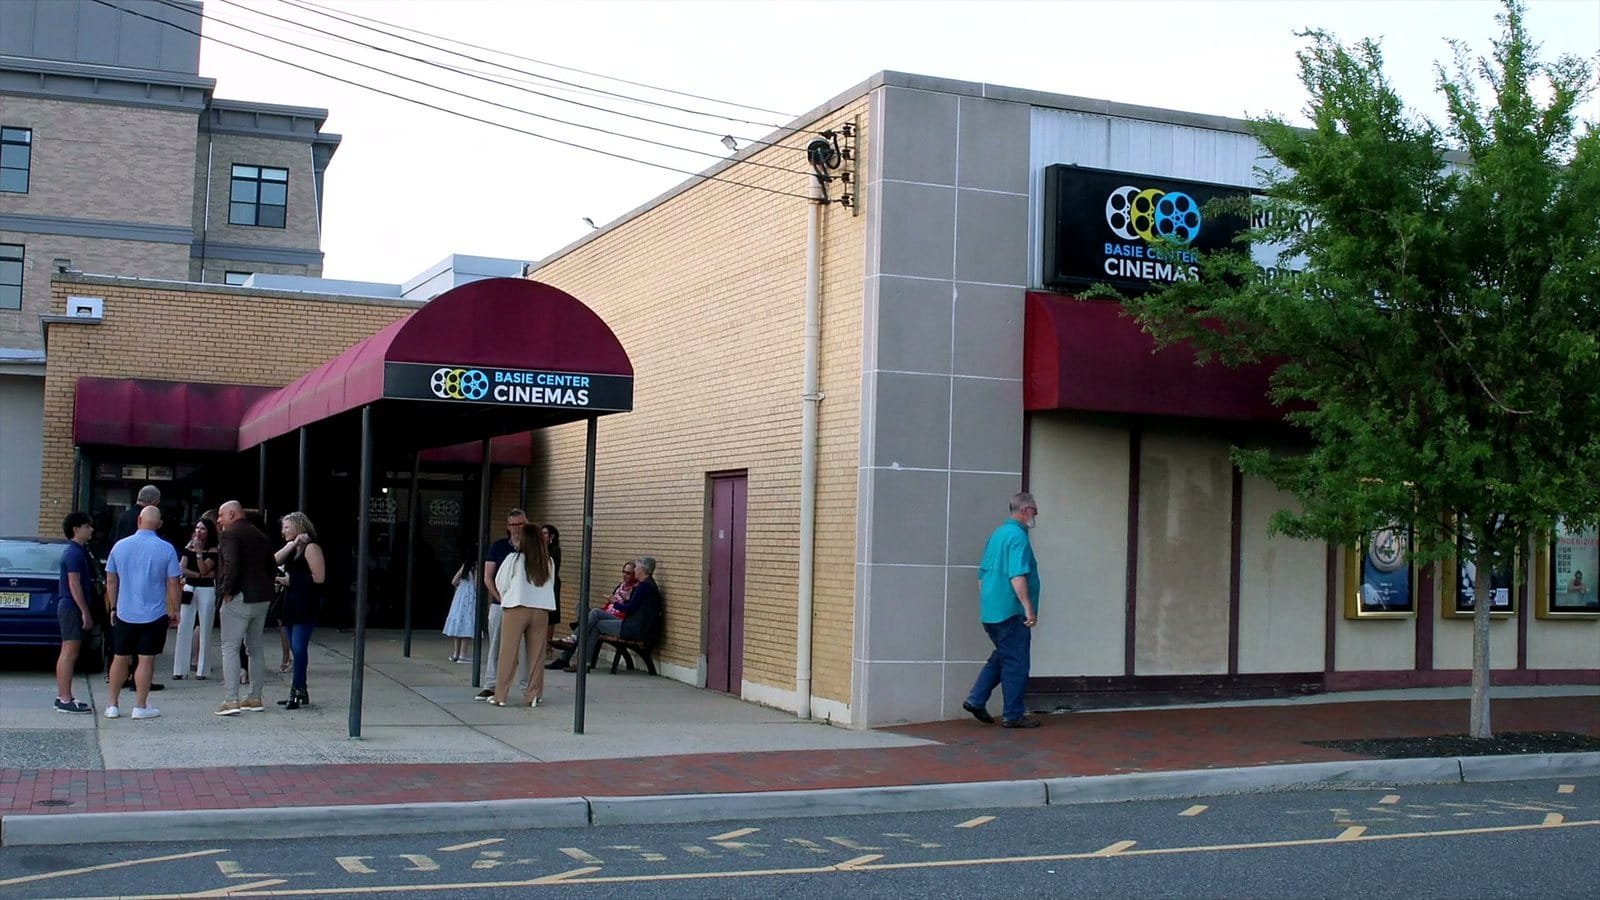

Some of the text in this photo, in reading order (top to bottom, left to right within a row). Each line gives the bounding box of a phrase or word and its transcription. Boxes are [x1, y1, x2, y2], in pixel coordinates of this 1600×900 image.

[1104, 242, 1199, 264] BASIE CTER
[1104, 257, 1199, 282] CINEMAS
[495, 371, 590, 387] BASIE CENTER
[493, 385, 589, 406] CINEMAS
